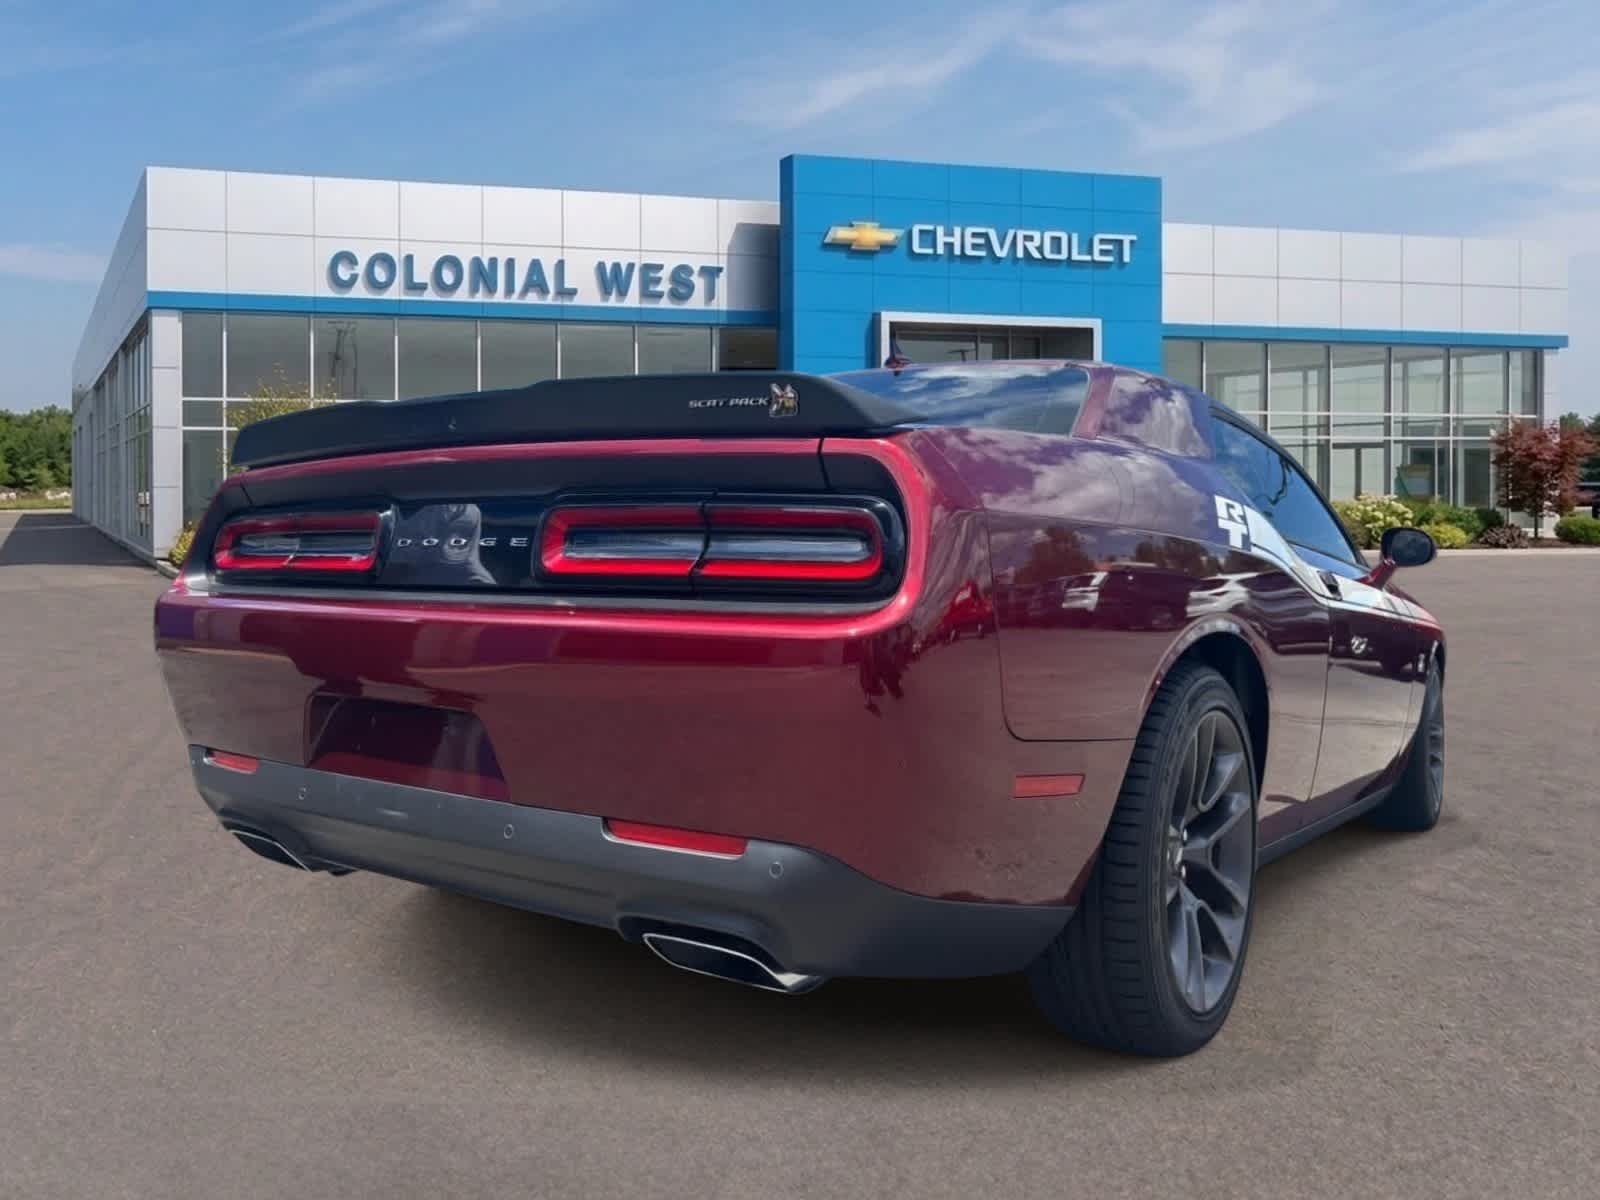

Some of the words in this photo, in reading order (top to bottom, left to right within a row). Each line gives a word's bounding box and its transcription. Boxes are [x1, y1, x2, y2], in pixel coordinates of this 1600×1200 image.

[911, 224, 1138, 263] CHEVROLET
[328, 250, 577, 299] COLONIAL
[596, 260, 724, 303] WEST
[688, 399, 726, 408] SCAT
[728, 397, 769, 406] PACK
[397, 537, 529, 547] DODGE
